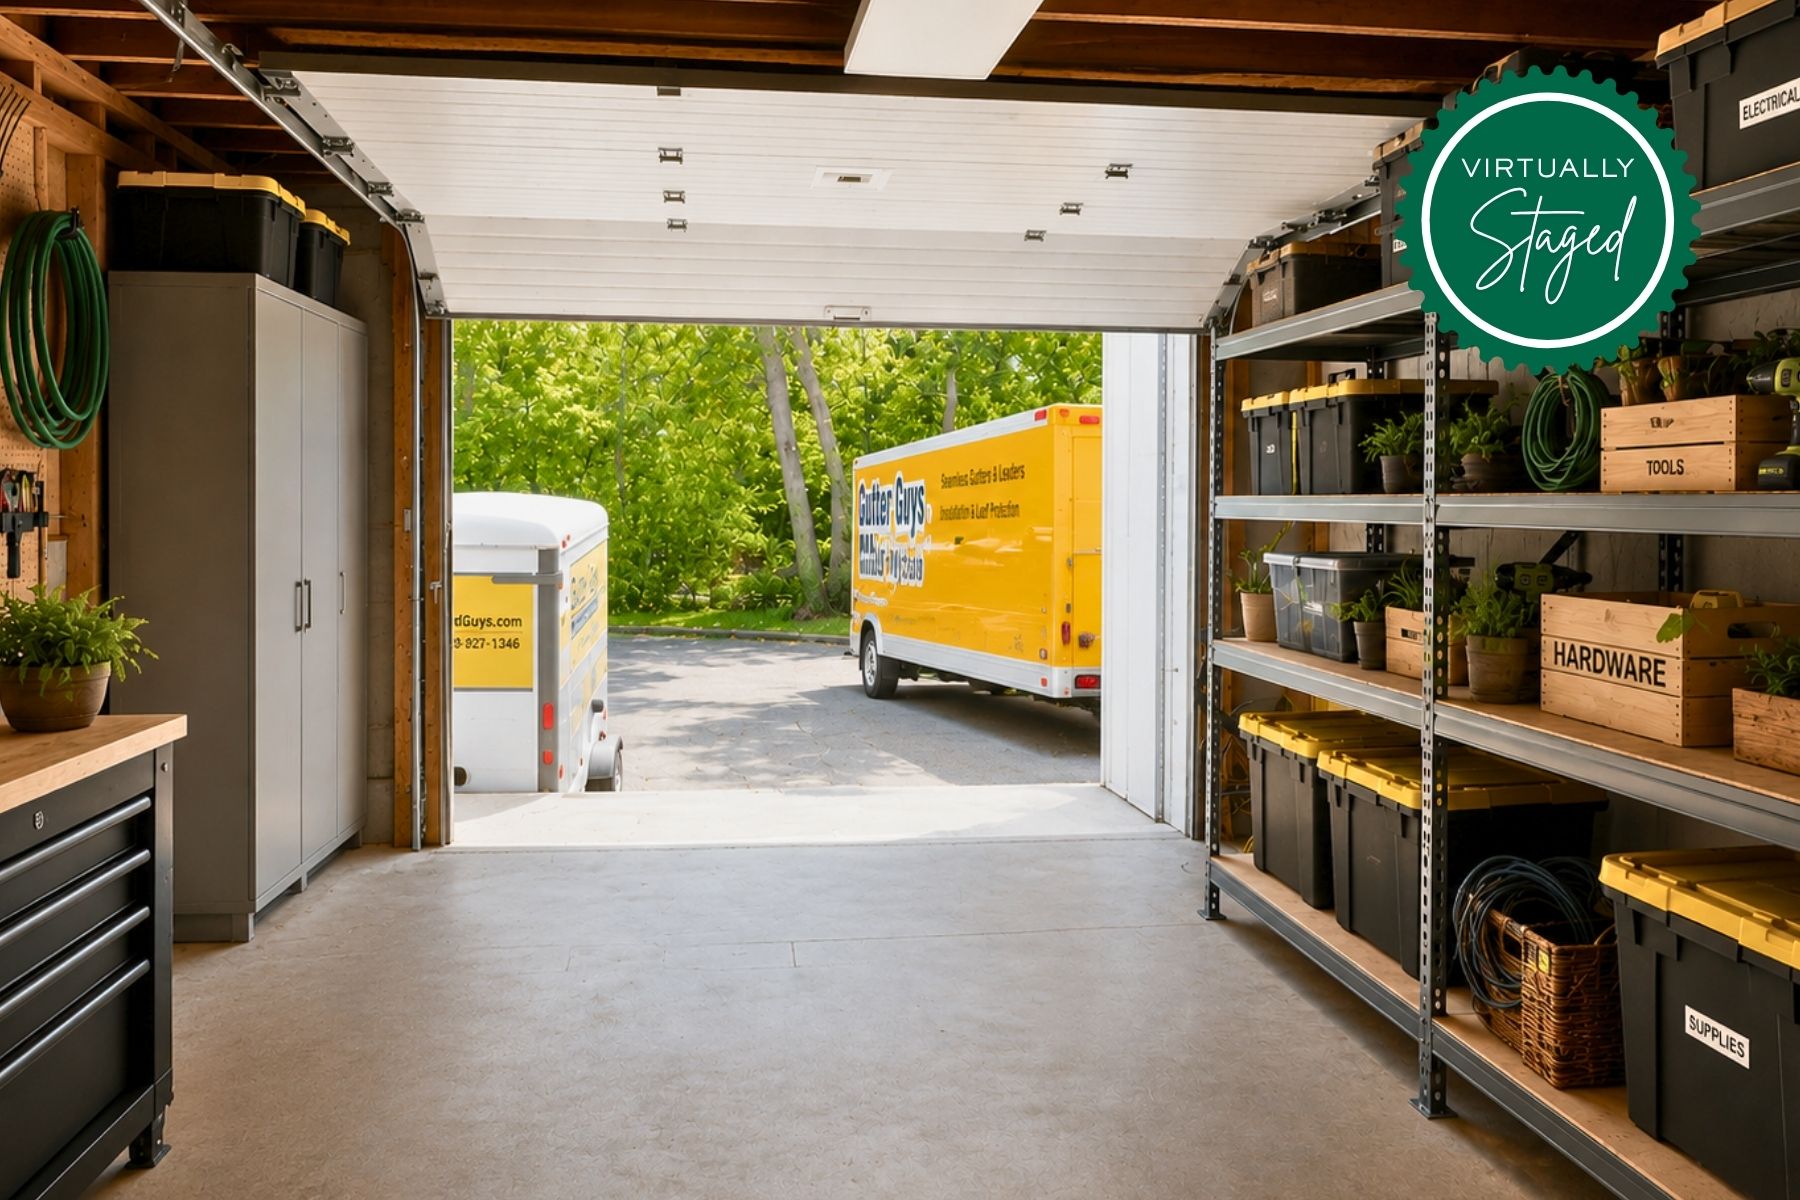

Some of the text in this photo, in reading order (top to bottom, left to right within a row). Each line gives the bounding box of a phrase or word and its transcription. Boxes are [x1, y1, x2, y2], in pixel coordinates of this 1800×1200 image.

[1743, 86, 1800, 121] ELECTRICAL
[1646, 458, 1685, 476] TOOLS
[859, 475, 924, 538] Gutter Guys
[454, 614, 523, 630] dGuys.com
[1554, 641, 1666, 688] HARDWARE
[1689, 1014, 1745, 1058] SUPPLIES
